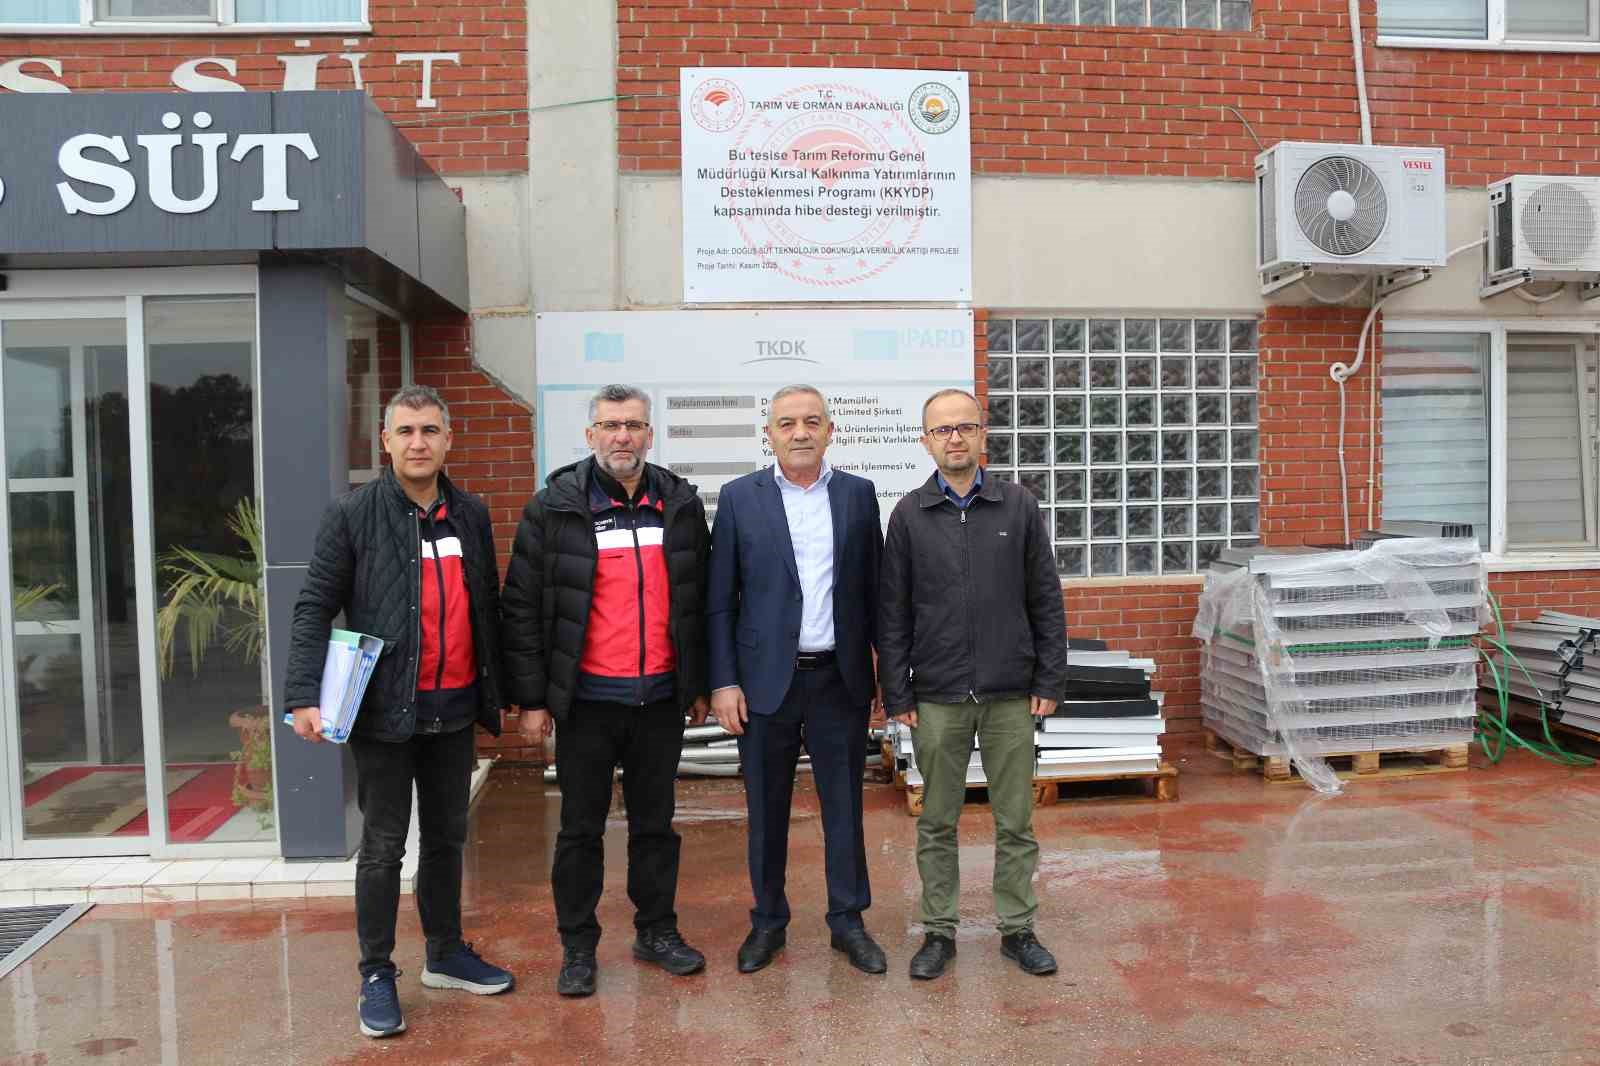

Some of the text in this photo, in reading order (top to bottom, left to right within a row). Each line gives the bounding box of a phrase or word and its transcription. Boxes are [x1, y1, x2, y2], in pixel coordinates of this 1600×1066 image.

[817, 89, 836, 98] T.C.
[749, 100, 905, 112] TARIM VE ORMAN BAKANLIĞI
[728, 149, 926, 162] Bu tesise Tarım Reformu Genel
[56, 111, 320, 216] SÜT
[1402, 160, 1432, 169] VESTEL
[696, 167, 956, 182] Müdürlüğü Kırsal Kalkınma Yatırımlarının
[719, 186, 935, 201] Desteklenmesi Programı (KKYDP)
[713, 204, 942, 219] kapsamında hibe desteği verilmiştir.
[754, 340, 807, 357] TKDK
[833, 395, 879, 405] Mamülleri
[838, 407, 872, 416] Limited
[873, 407, 902, 417] Şirketi
[896, 422, 923, 435] İşlenm
[882, 435, 921, 444] Varlıklar
[830, 463, 859, 471] lerinin
[904, 462, 917, 470] Ve
